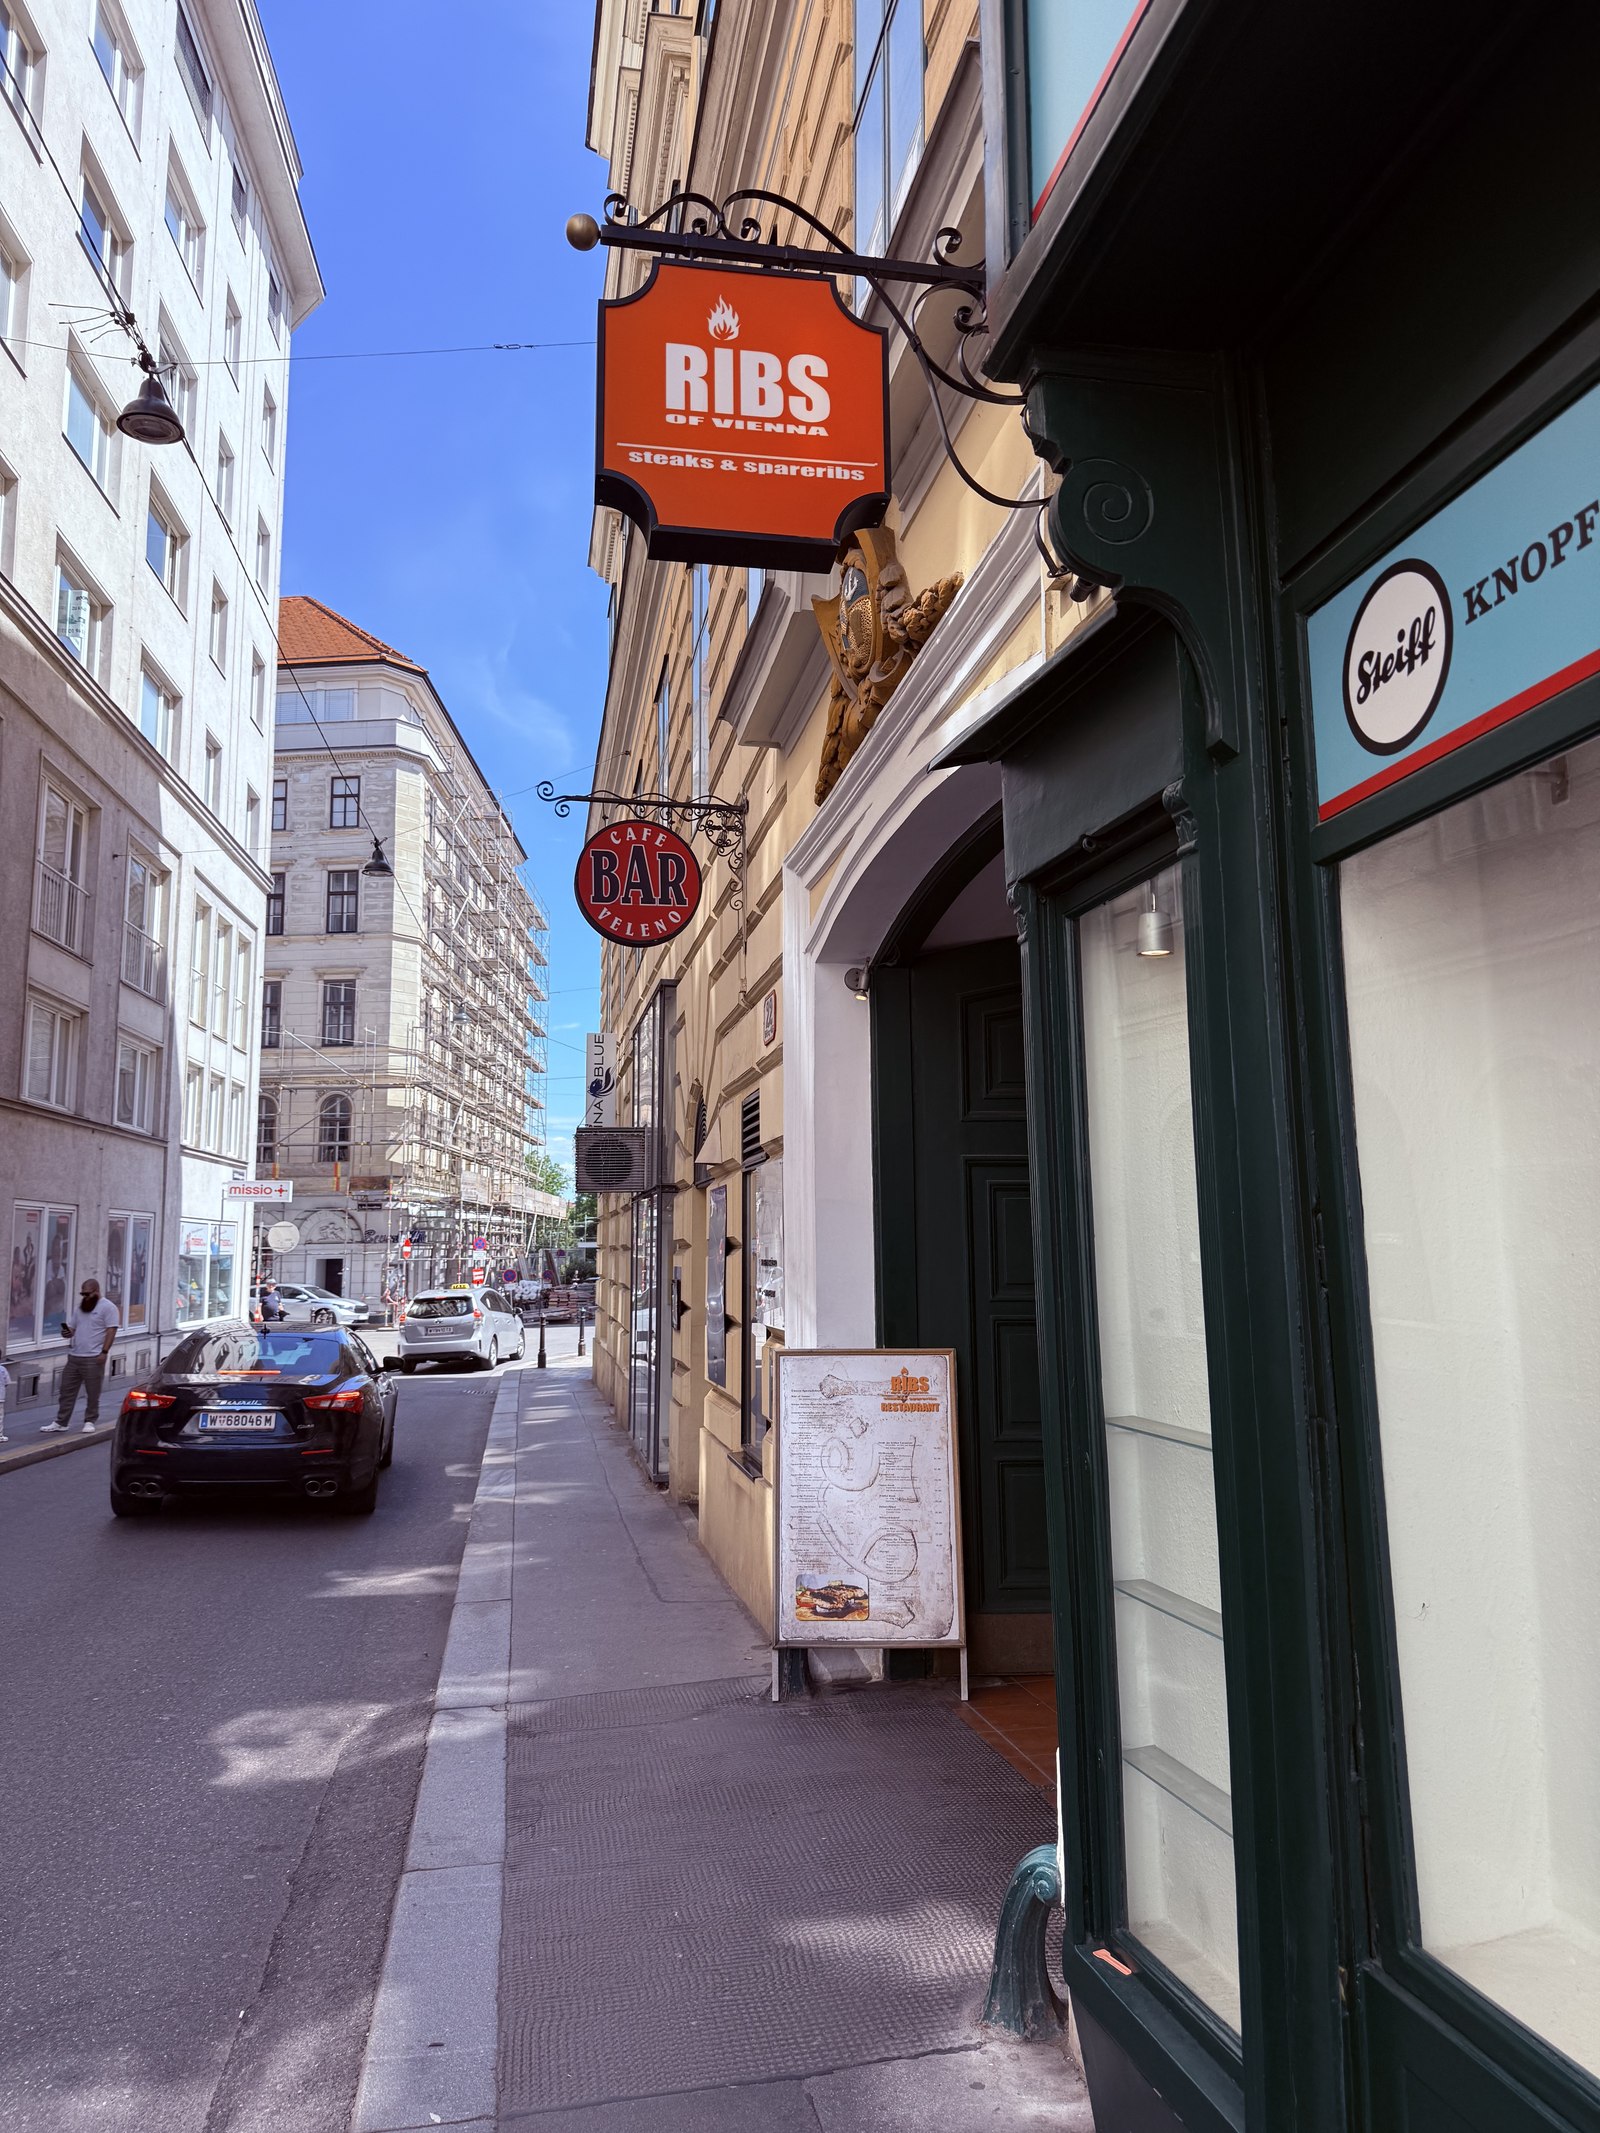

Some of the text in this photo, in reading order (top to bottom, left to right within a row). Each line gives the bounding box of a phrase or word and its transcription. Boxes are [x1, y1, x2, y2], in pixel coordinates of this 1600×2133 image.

[665, 342, 831, 423] RIBS
[665, 413, 829, 437] OF VIENNA
[628, 451, 865, 481] steaks & spareribs
[1356, 605, 1436, 705] Steiff
[610, 827, 667, 847] CAFE
[590, 843, 689, 907] BAR
[597, 906, 682, 937] VELENO
[594, 1034, 605, 1077] BLUE
[229, 1184, 273, 1195] missio
[891, 1376, 930, 1392] RIBS
[209, 1415, 217, 1426] W
[880, 1402, 941, 1413] RESTAURANT
